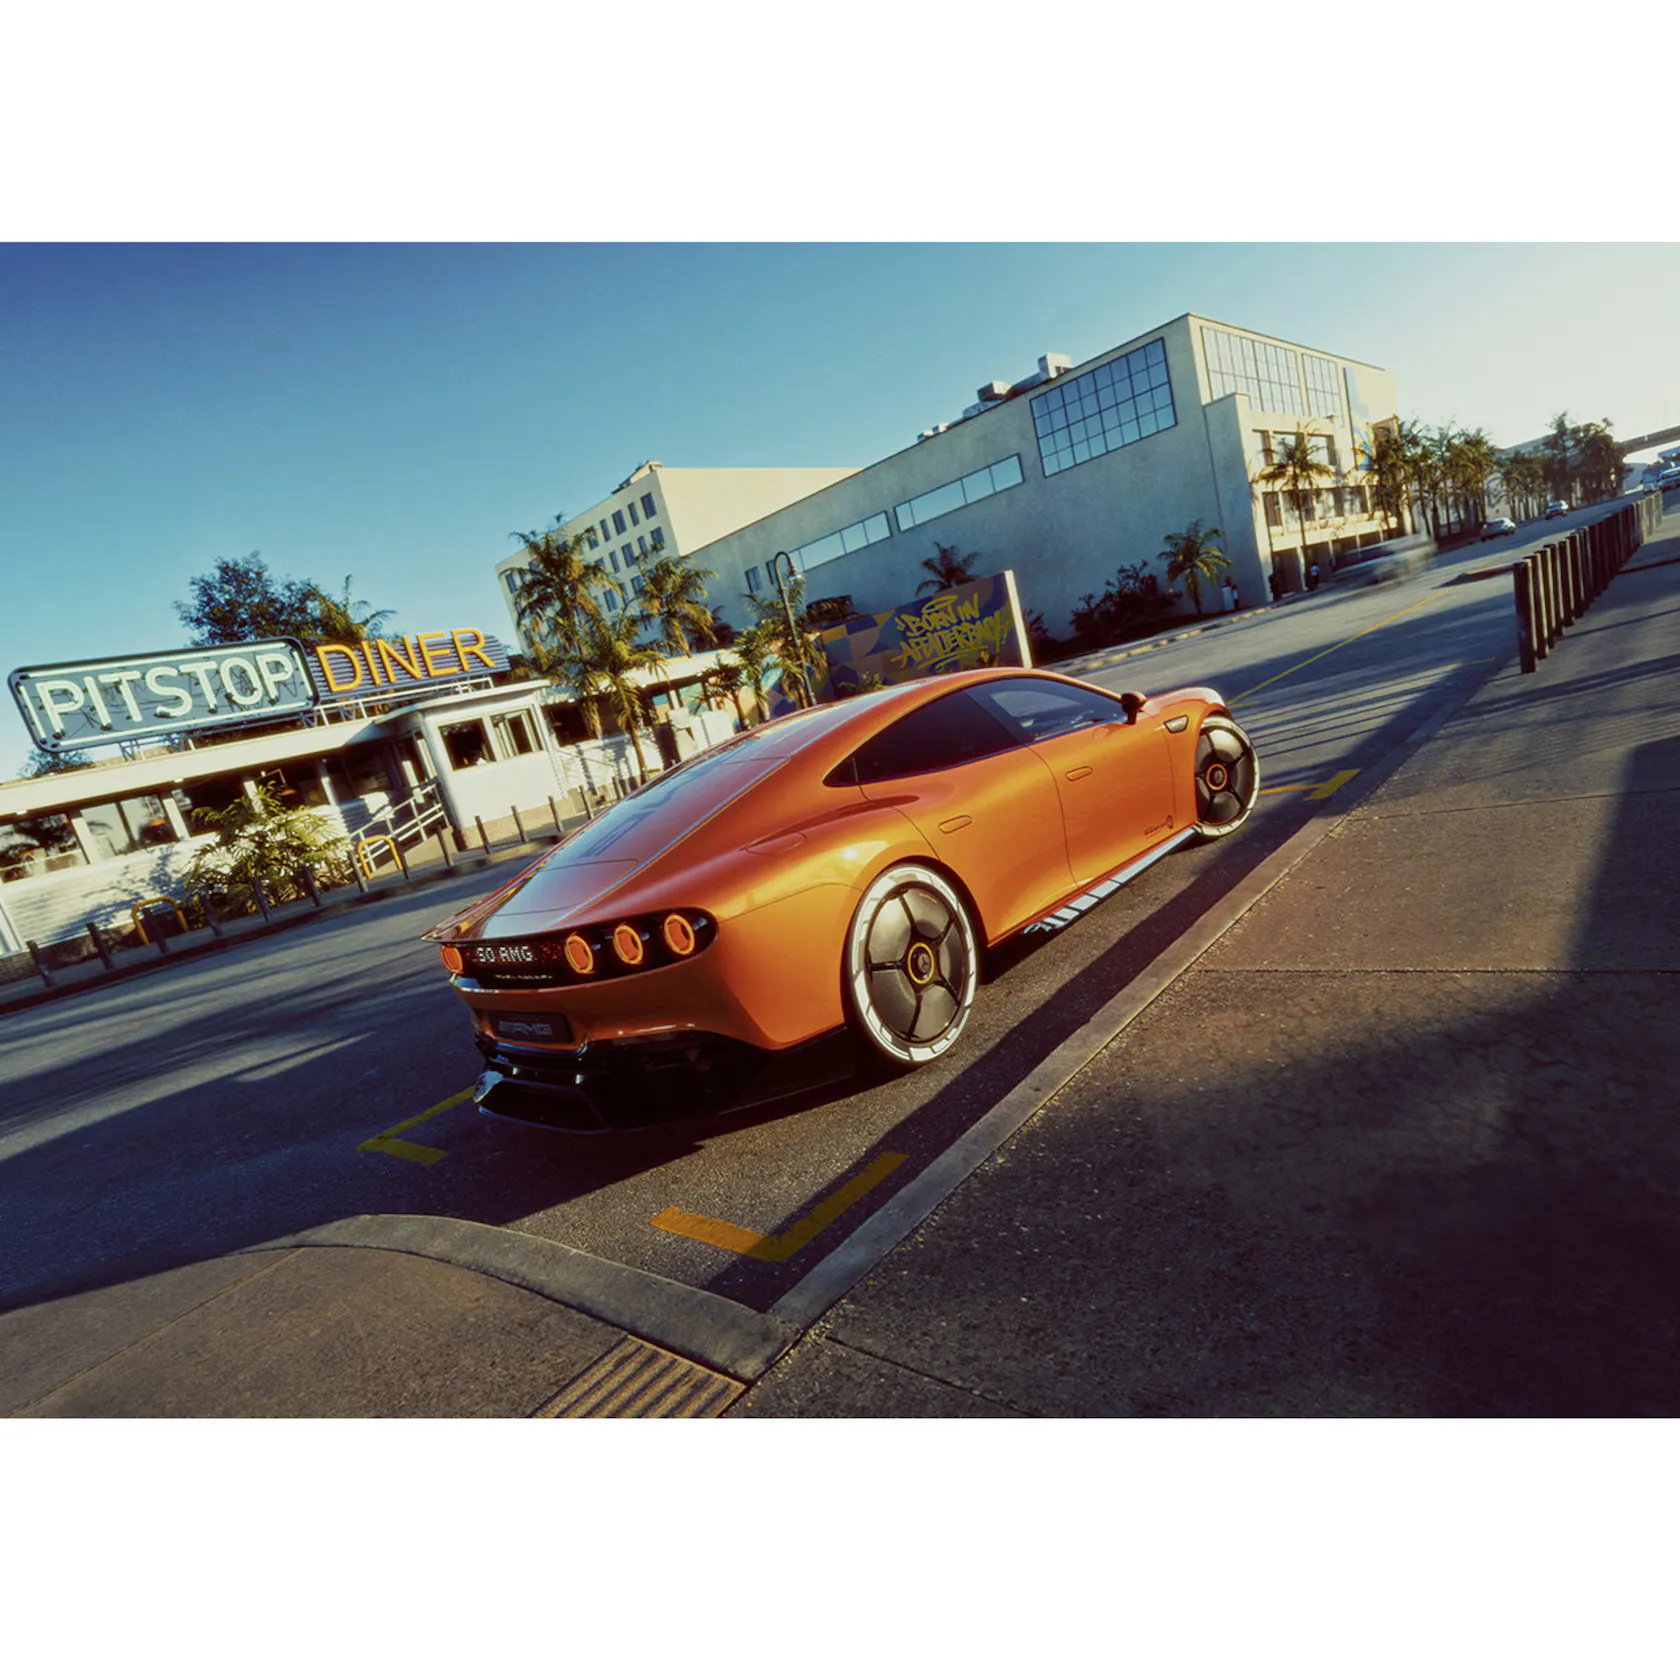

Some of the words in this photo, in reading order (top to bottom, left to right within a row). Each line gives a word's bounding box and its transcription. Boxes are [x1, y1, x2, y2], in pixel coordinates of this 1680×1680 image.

[957, 592, 980, 622] IN
[315, 626, 496, 693] DINER
[35, 652, 297, 736] PITSTOP
[499, 945, 533, 962] AMG
